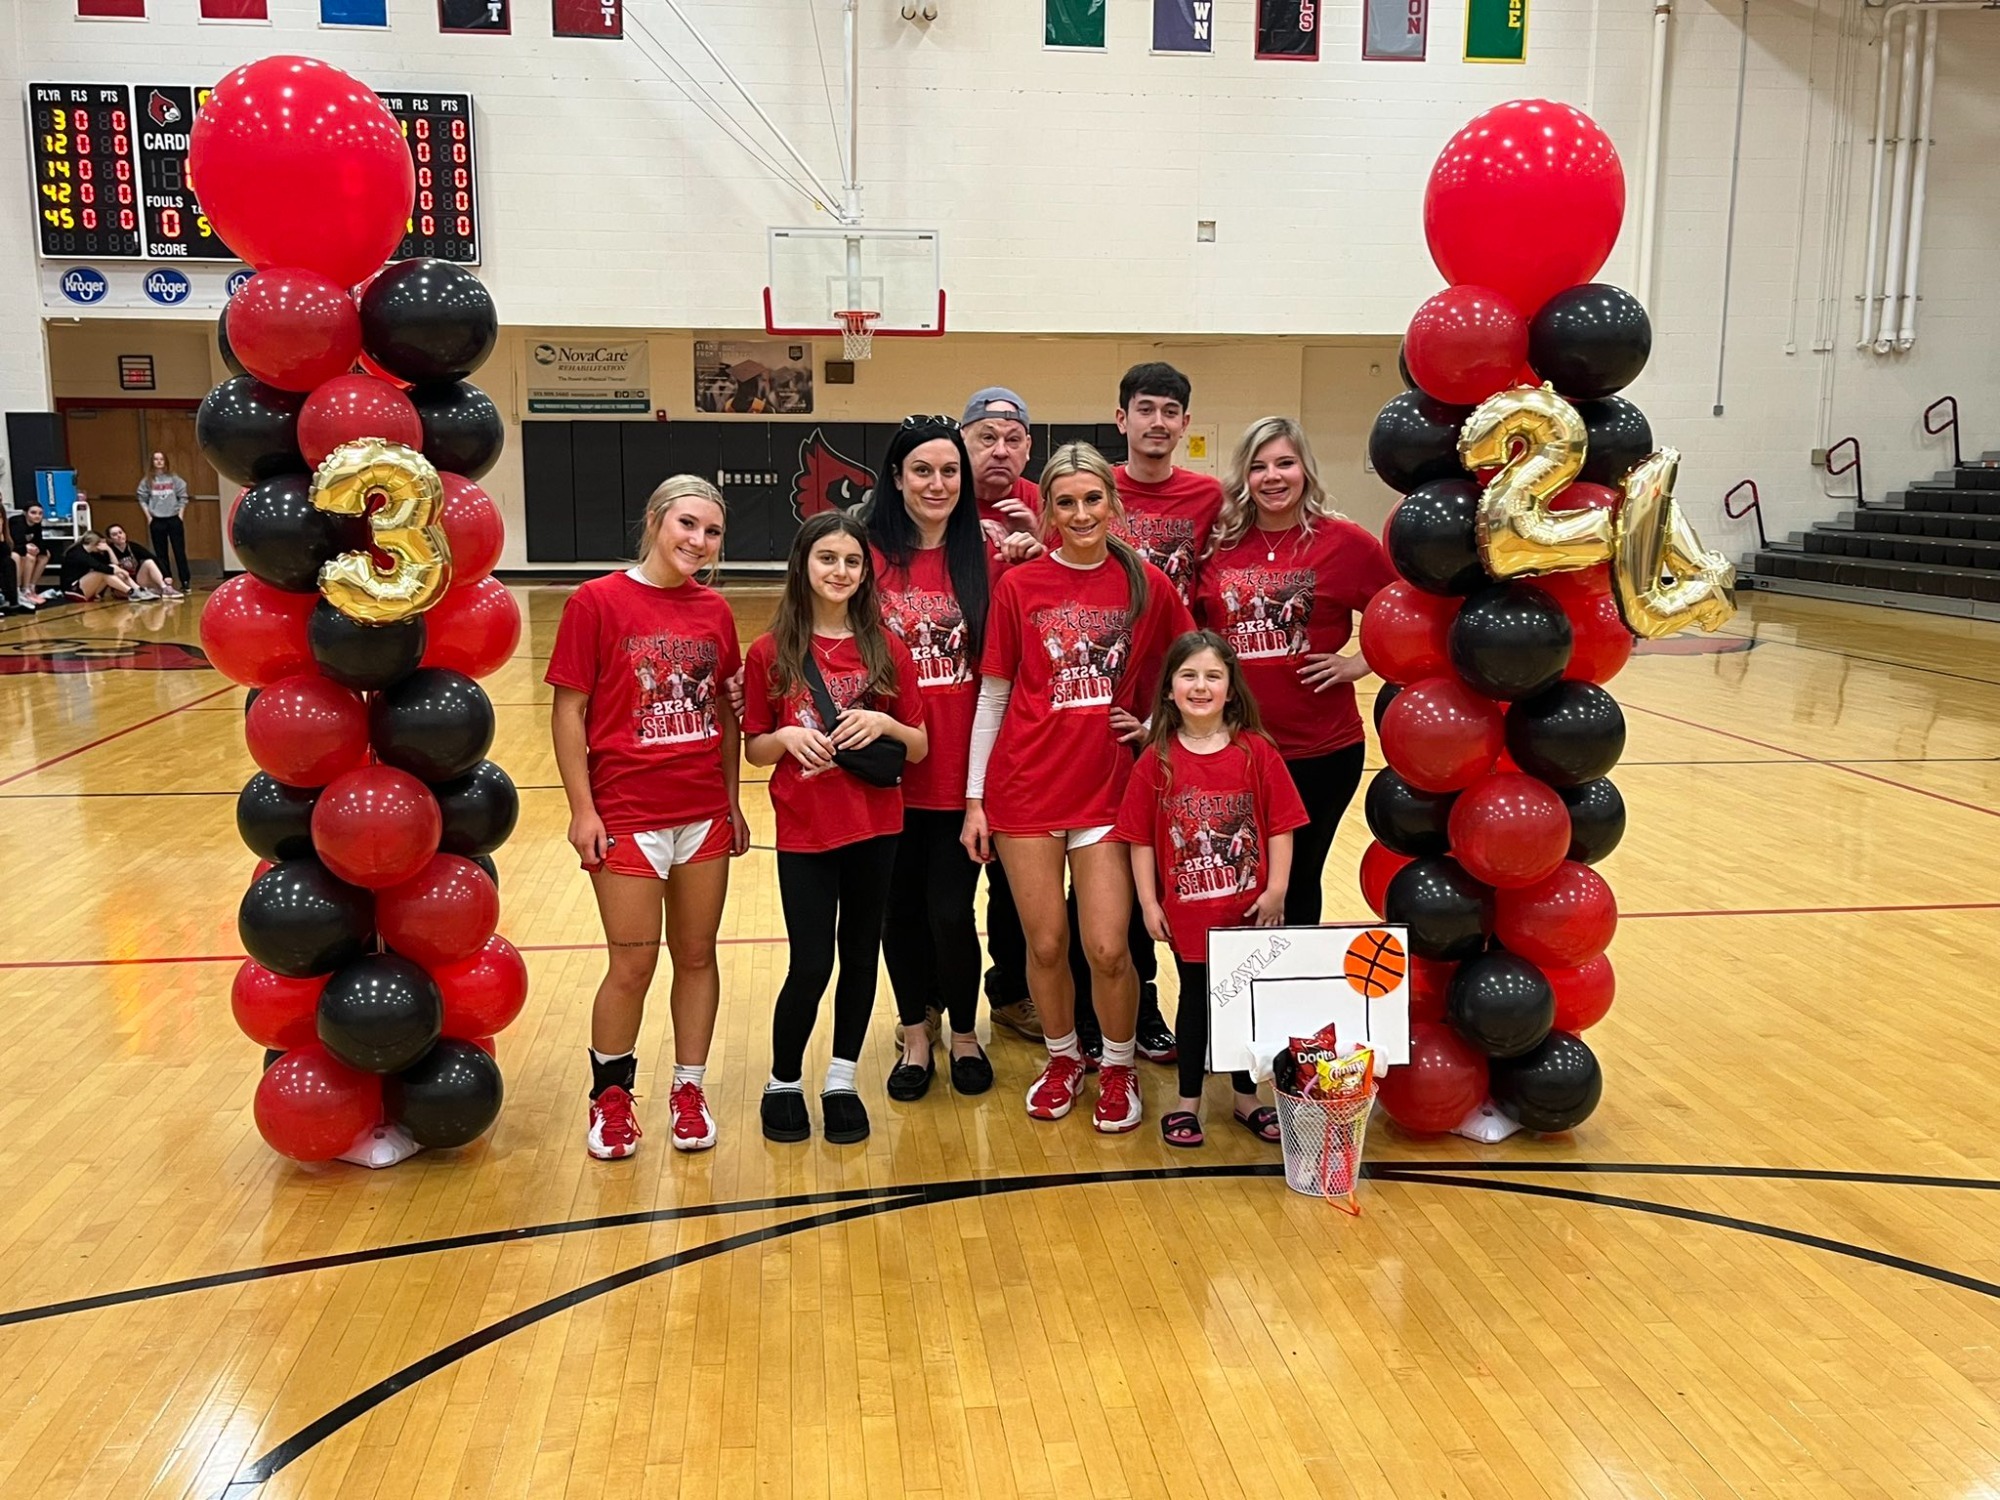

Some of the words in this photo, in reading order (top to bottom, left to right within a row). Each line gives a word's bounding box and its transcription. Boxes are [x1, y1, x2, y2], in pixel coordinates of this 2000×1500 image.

[38, 90, 61, 102] PLYR
[71, 90, 88, 102] FLS
[100, 91, 118, 102] PTS
[413, 99, 428, 110] FLS
[442, 100, 458, 111] PTS
[52, 110, 66, 130] 3
[75, 110, 88, 130] 0
[112, 111, 125, 131] 0
[416, 119, 428, 139] 0
[452, 120, 464, 139] 0
[46, 134, 67, 154] 12
[77, 134, 90, 154] 0
[114, 134, 128, 155] 0
[417, 142, 430, 162] 0
[454, 143, 466, 163] 0
[48, 161, 70, 178] 14
[79, 160, 92, 180] 0
[116, 160, 129, 180] 0
[419, 168, 431, 188] 0
[455, 168, 467, 188] 0
[42, 183, 72, 203] 42
[80, 183, 94, 203] 0
[118, 184, 131, 204] 0
[147, 196, 183, 208] FOULS
[420, 191, 433, 210] 0
[456, 191, 468, 211] 0
[45, 208, 74, 229] 45
[83, 209, 96, 229] 0
[120, 209, 133, 229] 0
[162, 210, 180, 237] 0
[422, 216, 434, 235] 0
[457, 216, 470, 236] 0
[151, 244, 187, 255] SCORE
[65, 272, 104, 300] Kroger
[148, 273, 186, 301] Kroger
[558, 348, 628, 362] NovaCare
[1236, 618, 1275, 634] 2K24
[1228, 630, 1288, 654] SENIOR
[910, 645, 941, 660] K24
[918, 657, 954, 680] NIOR
[1061, 664, 1099, 681] 2K24
[1054, 676, 1112, 704] SENIOR
[652, 698, 694, 716] 2K24
[642, 711, 701, 739] SENIOR
[1184, 853, 1224, 872] 2K24
[1178, 866, 1237, 896] SENIOR
[1211, 935, 1291, 1007] KAYLA
